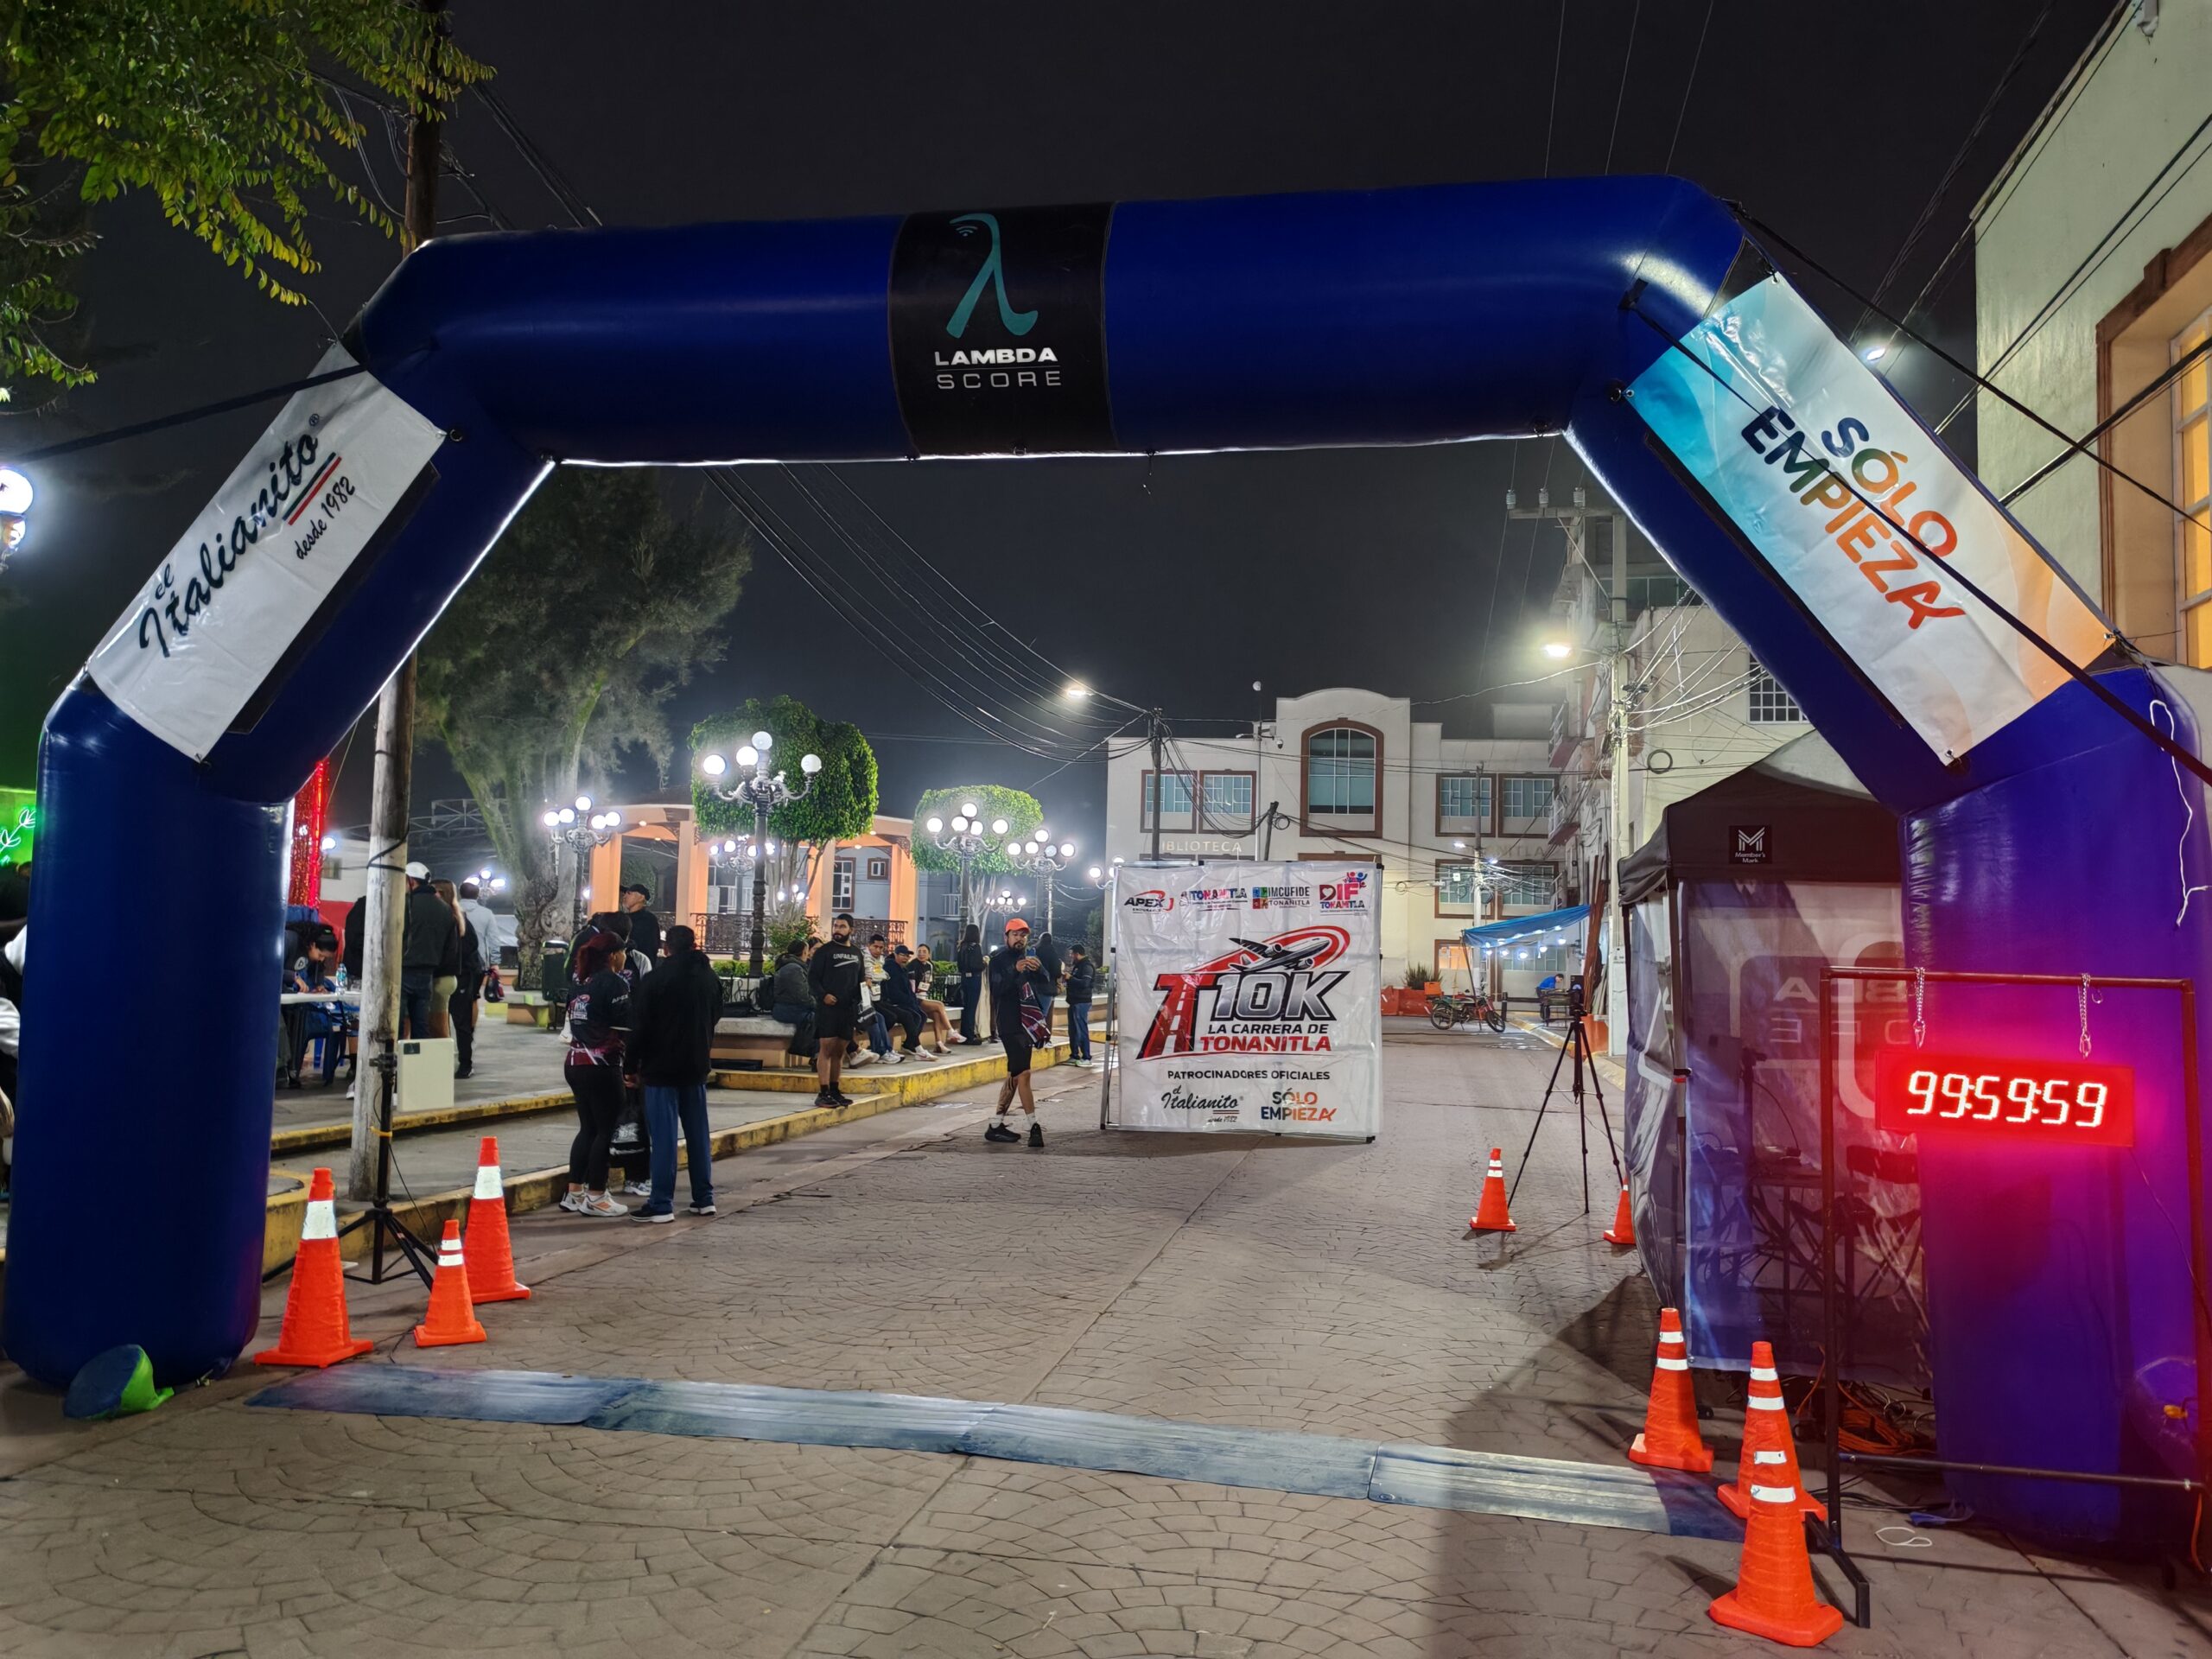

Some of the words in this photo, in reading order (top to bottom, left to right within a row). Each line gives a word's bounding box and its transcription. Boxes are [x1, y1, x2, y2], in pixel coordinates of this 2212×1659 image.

[934, 346, 1058, 366] LAMBDA
[936, 370, 1062, 390] SCORE
[1821, 416, 1958, 558] SÓLO
[294, 519, 327, 560] desde
[321, 476, 356, 519] 1982
[1740, 404, 1967, 630] EMPIEZA
[138, 432, 318, 659] Italianito
[155, 563, 174, 601] el
[1161, 841, 1243, 853] IBLIOTECA
[1268, 887, 1310, 897] IMCUFIDE
[1319, 883, 1359, 901] DIF
[1123, 897, 1165, 908] APEX
[1208, 1023, 1227, 1034] LA
[1230, 1023, 1303, 1034] CARRERA
[1306, 1023, 1329, 1034] DE
[1199, 1035, 1332, 1052] TONANITLA
[1167, 1070, 1268, 1080] PATROCINADORES
[1270, 1071, 1331, 1080] OFICIALES
[1173, 1084, 1182, 1095] el
[1272, 1087, 1318, 1105] SÓLO
[1161, 1091, 1239, 1109] Italianito
[1261, 1106, 1338, 1122] EMPIEZA
